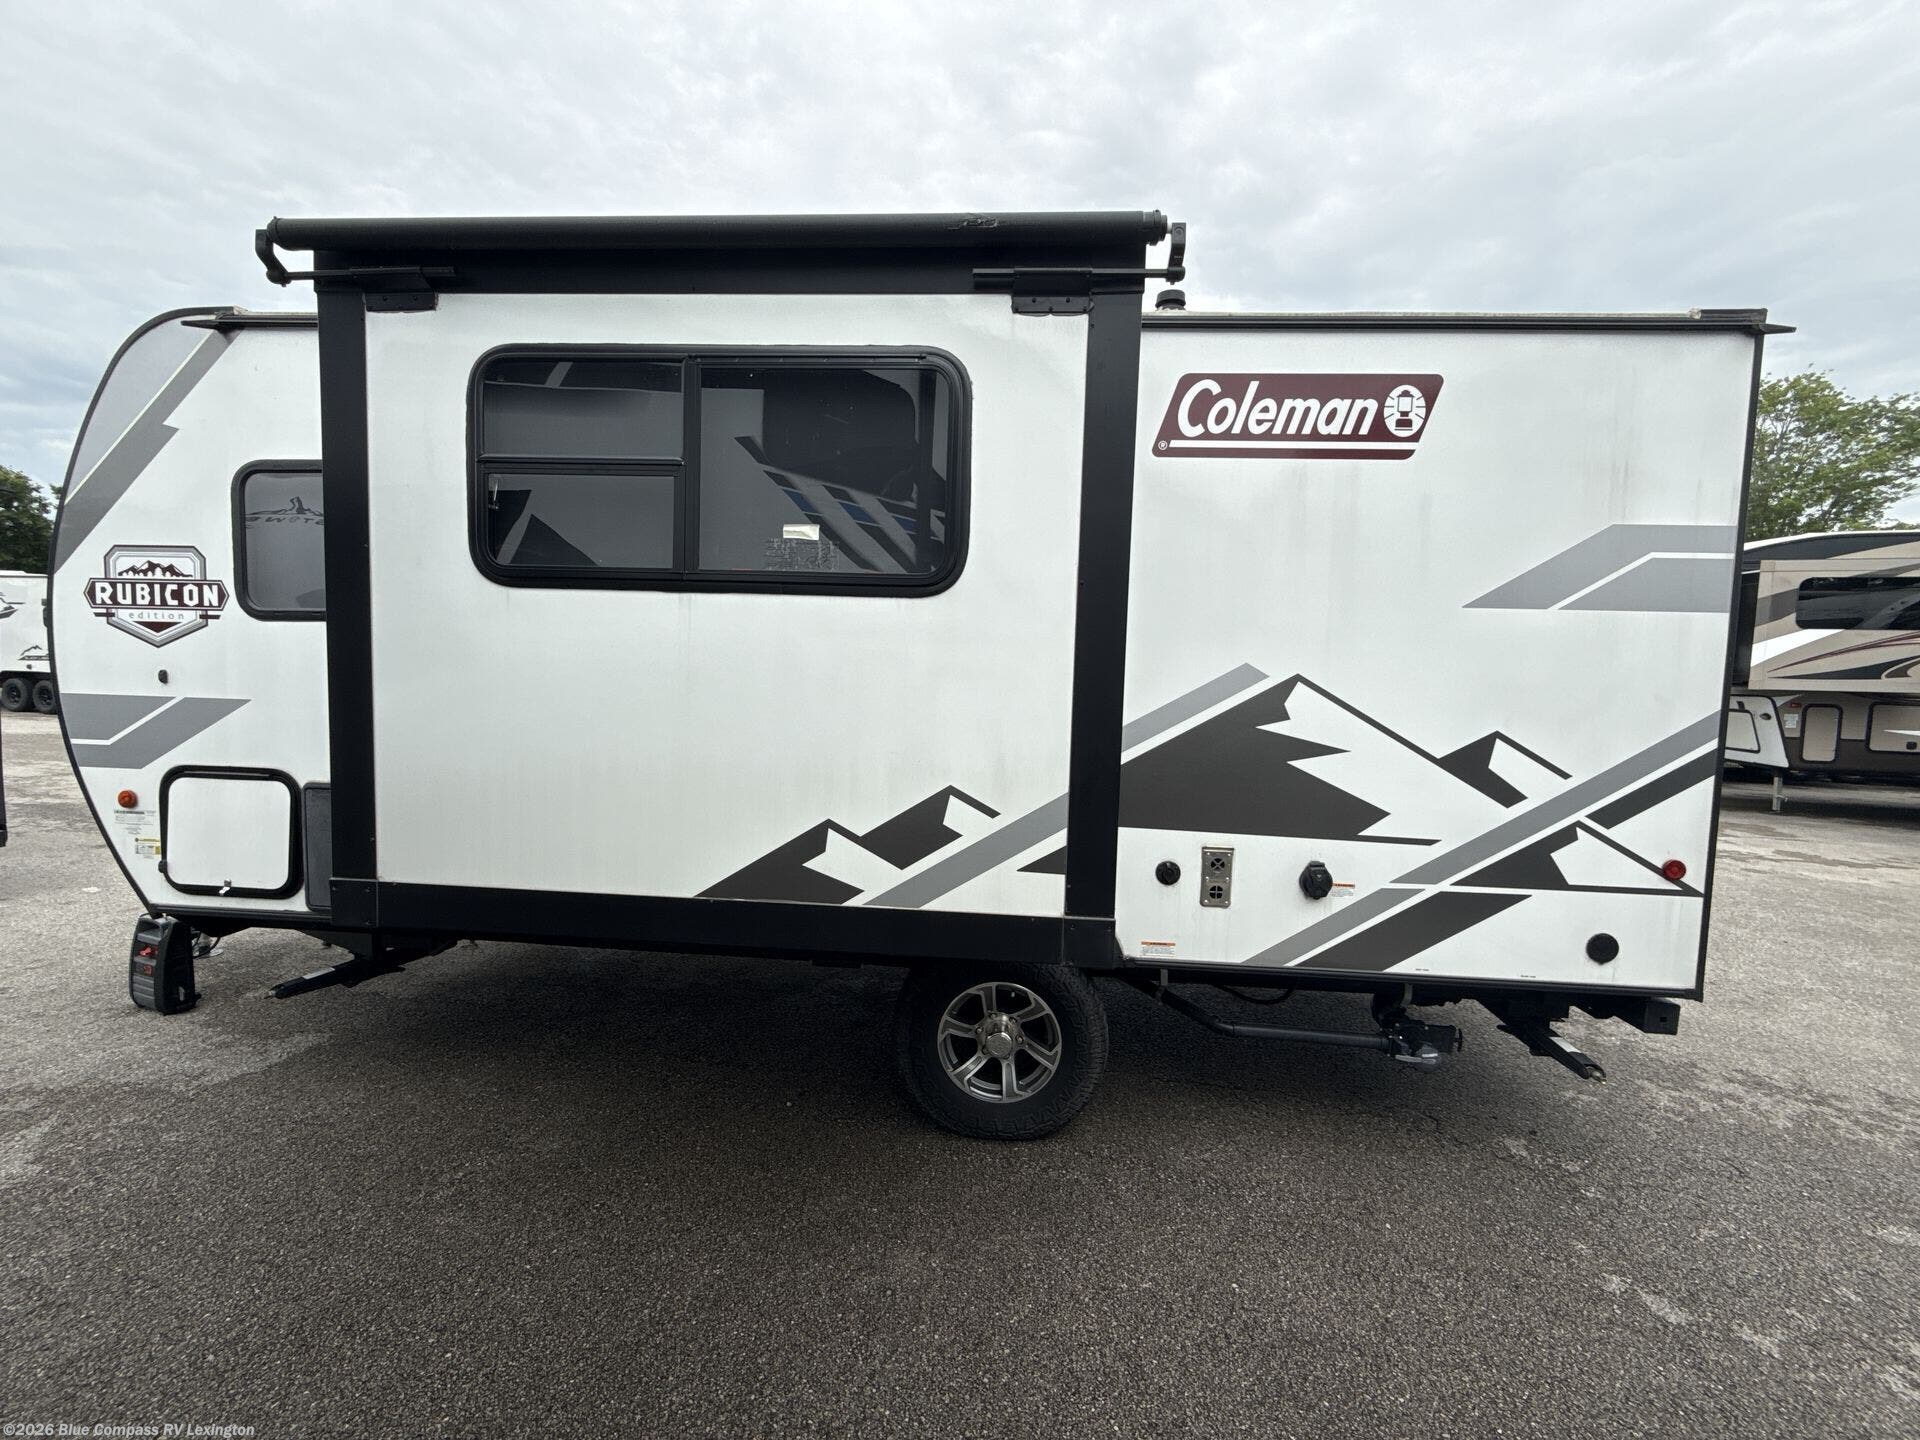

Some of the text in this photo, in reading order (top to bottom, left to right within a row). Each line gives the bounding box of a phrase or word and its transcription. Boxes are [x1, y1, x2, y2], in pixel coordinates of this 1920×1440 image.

[1177, 378, 1379, 438] Coleman
[94, 581, 220, 607] RUBICON
[128, 611, 185, 620] edition
